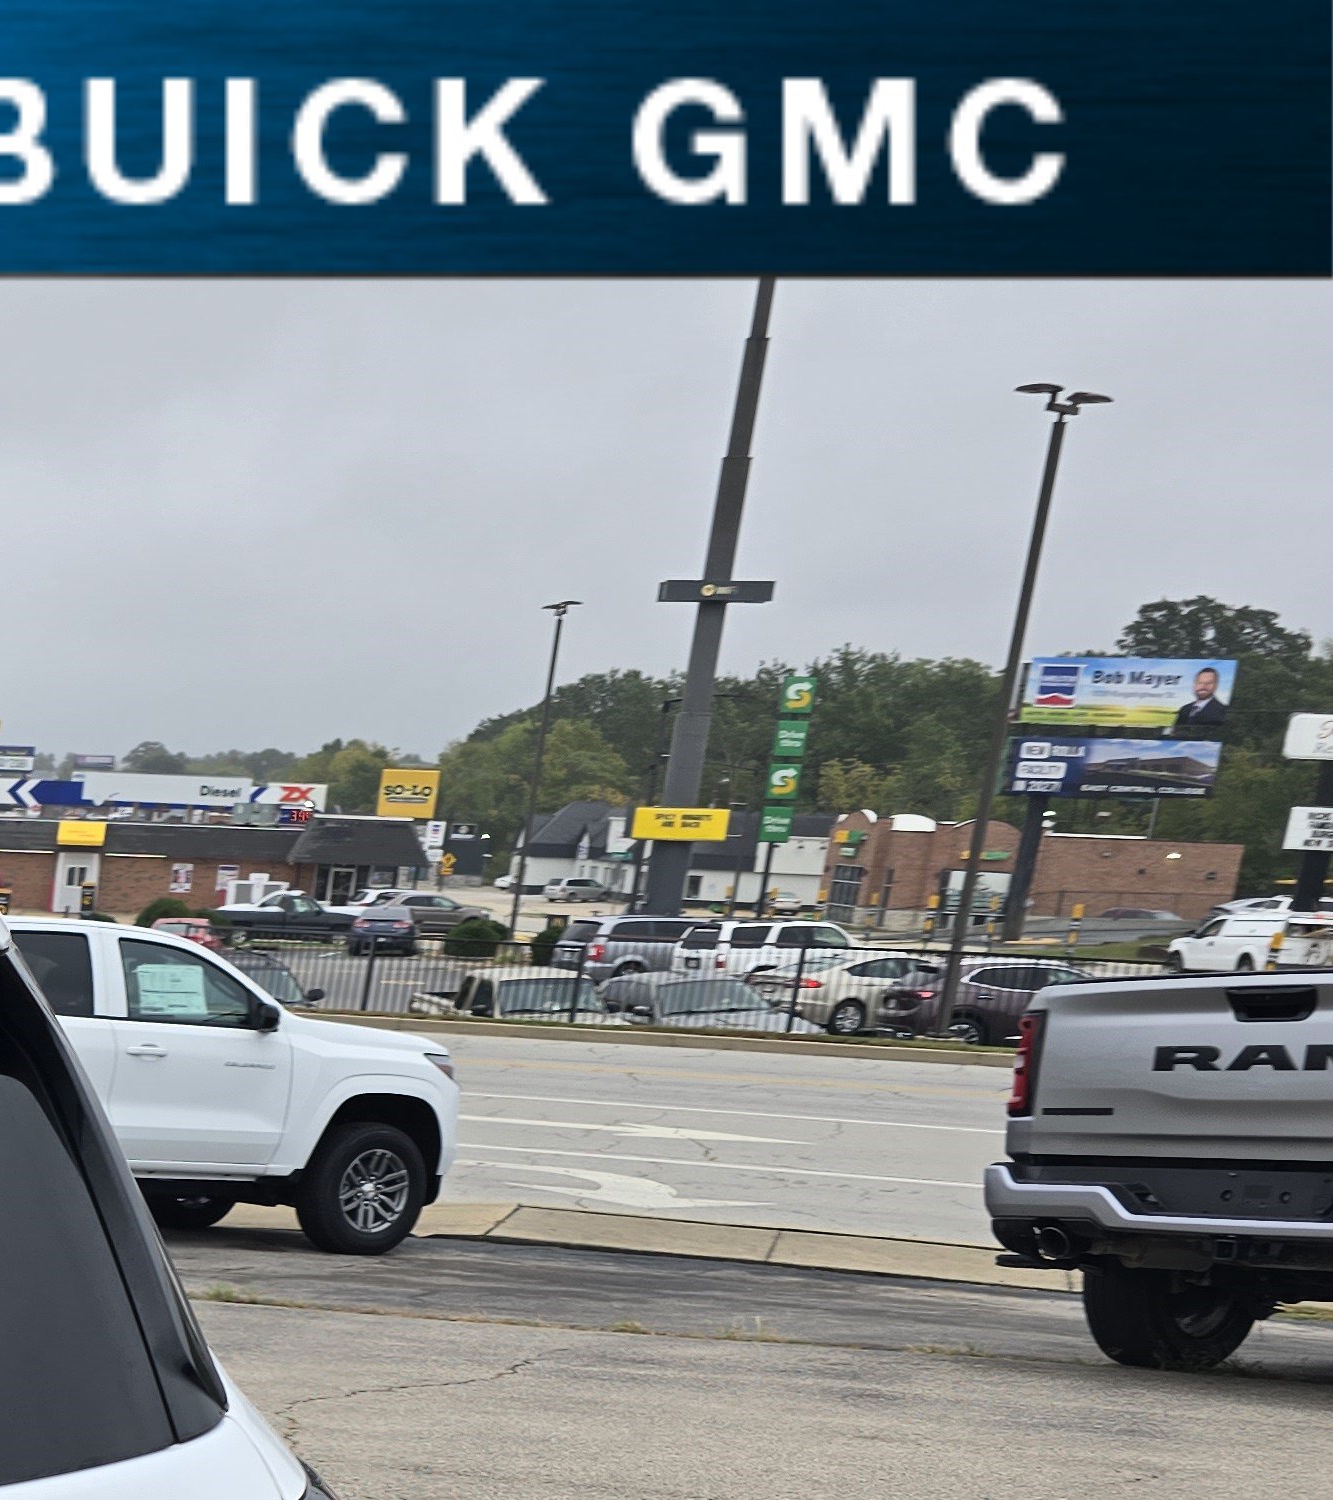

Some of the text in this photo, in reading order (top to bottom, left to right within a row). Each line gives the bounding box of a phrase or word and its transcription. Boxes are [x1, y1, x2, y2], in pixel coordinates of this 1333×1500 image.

[1091, 670, 1123, 685] Bob
[1127, 671, 1183, 688] Mayer
[199, 785, 242, 797] Diesel
